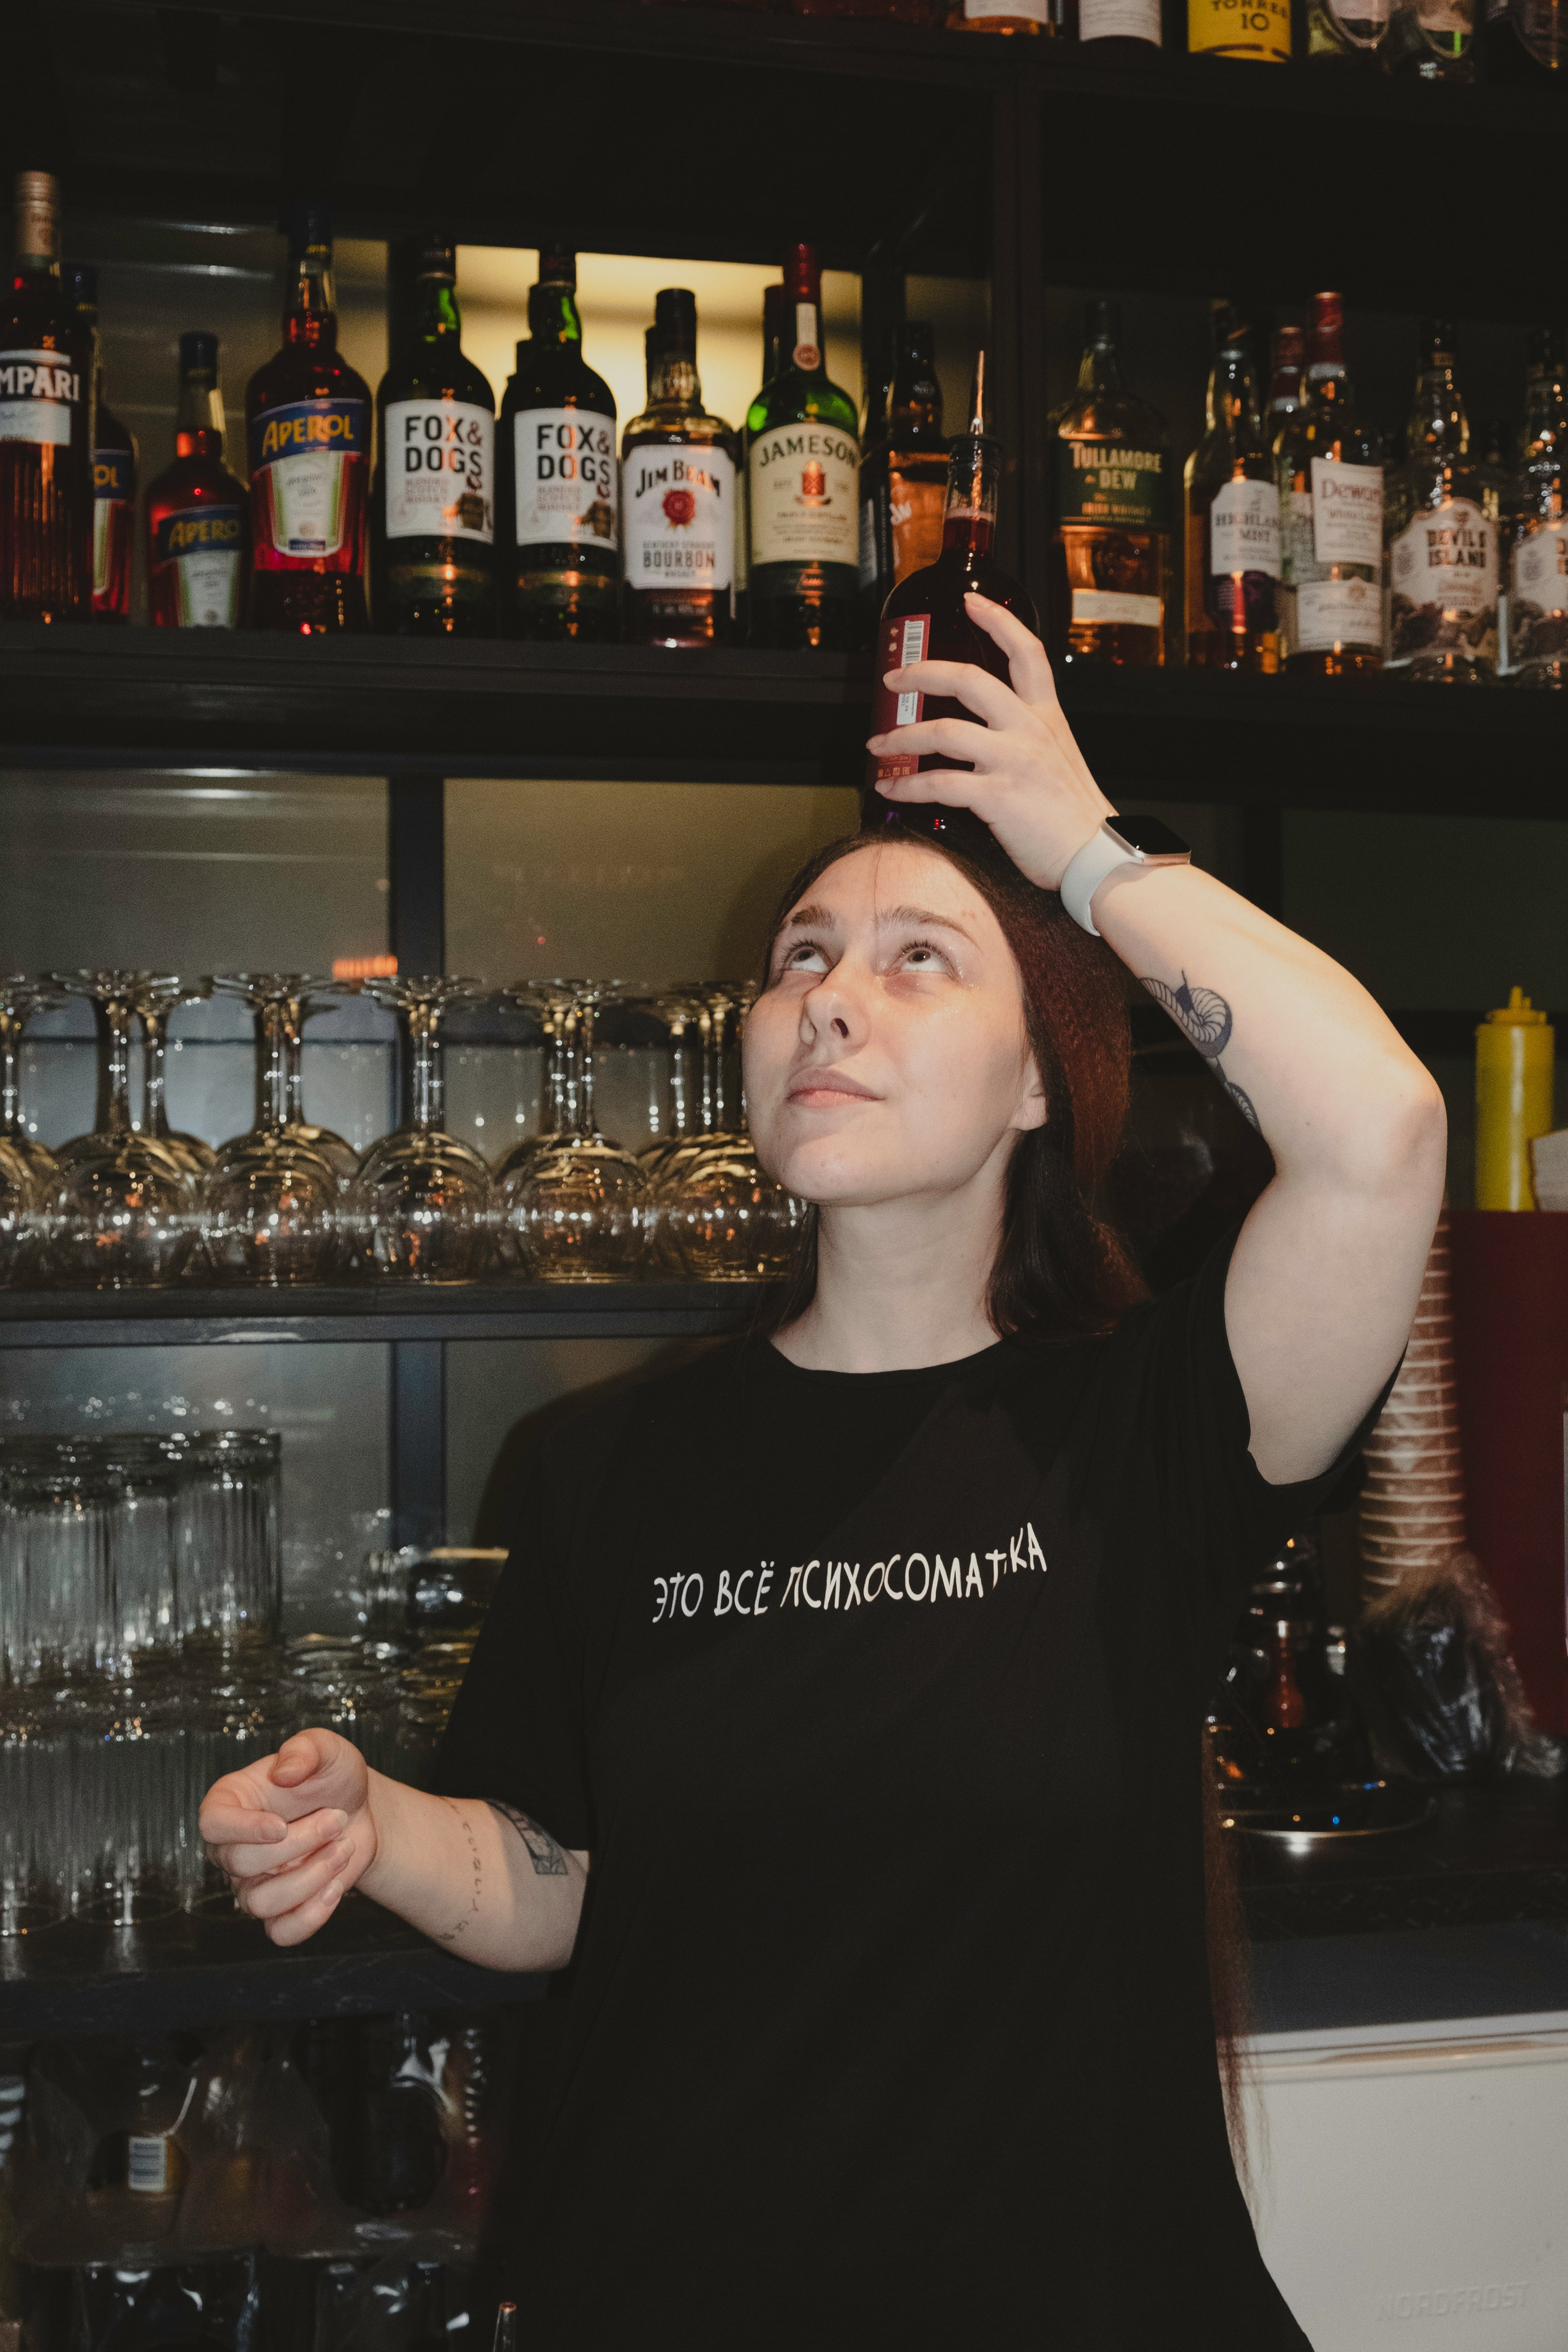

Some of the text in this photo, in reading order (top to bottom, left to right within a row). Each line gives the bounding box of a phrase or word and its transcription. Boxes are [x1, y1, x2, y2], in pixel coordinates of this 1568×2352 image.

[1242, 12, 1270, 31] 10
[262, 414, 355, 458] APEROL
[760, 434, 857, 469] JAMESON
[405, 445, 482, 477] DOGS
[537, 454, 610, 485] DOGS
[1069, 441, 1163, 473] TULLAMORE
[635, 459, 721, 499] JIM BEAM
[1099, 468, 1137, 491] DEW
[643, 551, 716, 568] BOURBON
[651, 1521, 1048, 1624] ЭТО ВСЁ ПСИХОСОМАТКА
